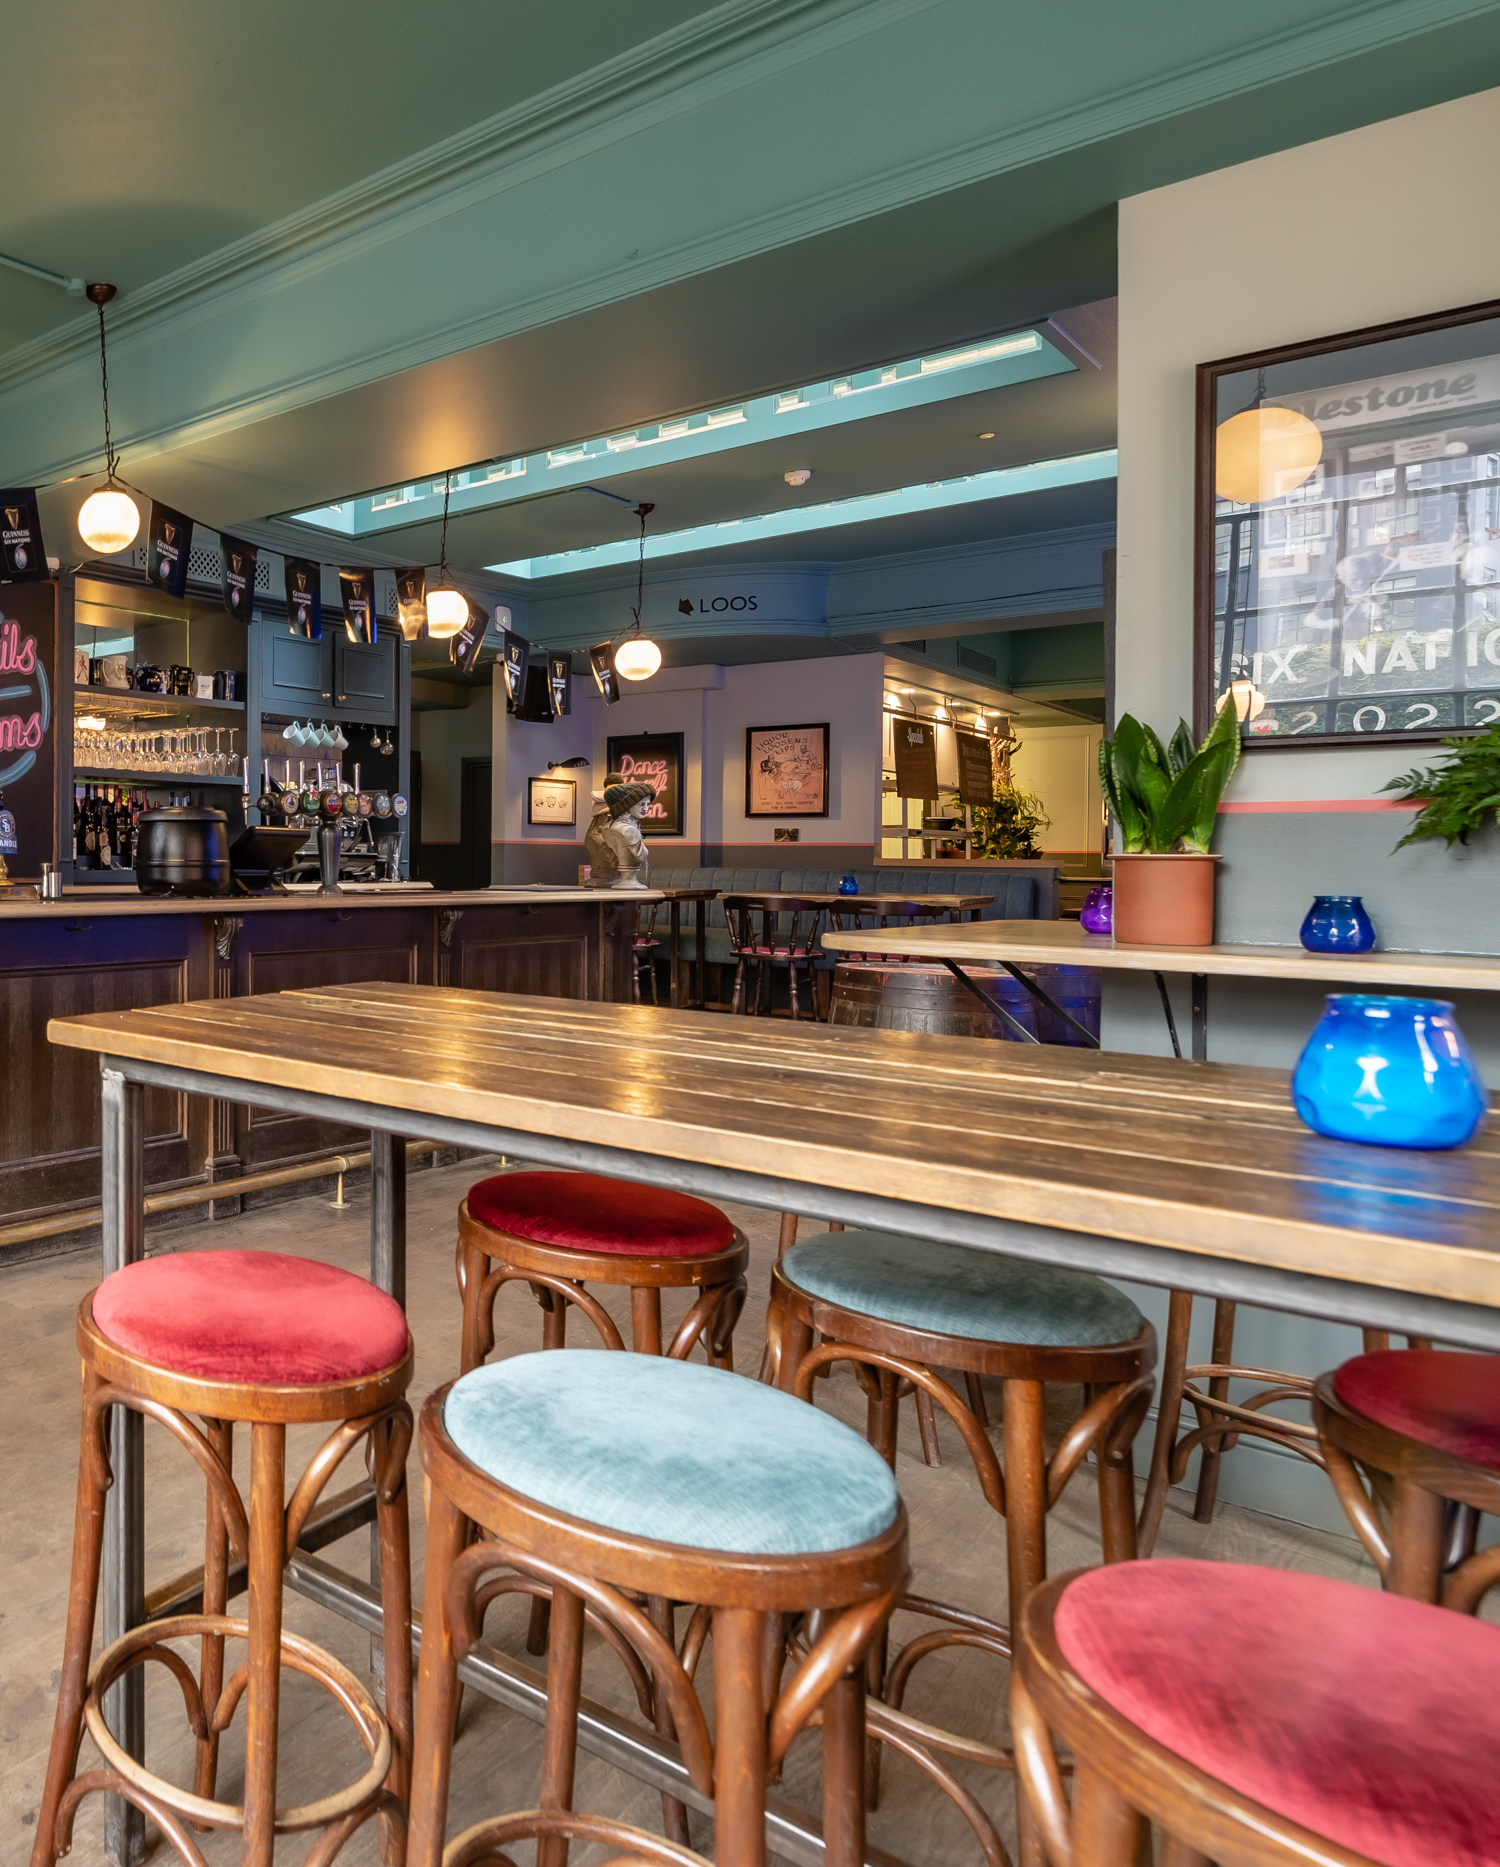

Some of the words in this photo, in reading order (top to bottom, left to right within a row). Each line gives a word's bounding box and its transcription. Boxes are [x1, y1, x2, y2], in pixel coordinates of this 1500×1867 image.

[3, 529, 29, 538] GUINNESS
[157, 540, 178, 555] GUINNESS
[700, 596, 757, 613] LOOS
[756, 732, 788, 751] LIQUOR
[763, 738, 807, 753] LOOSENS
[775, 745, 795, 755] LIPS
[621, 755, 668, 775] Dance
